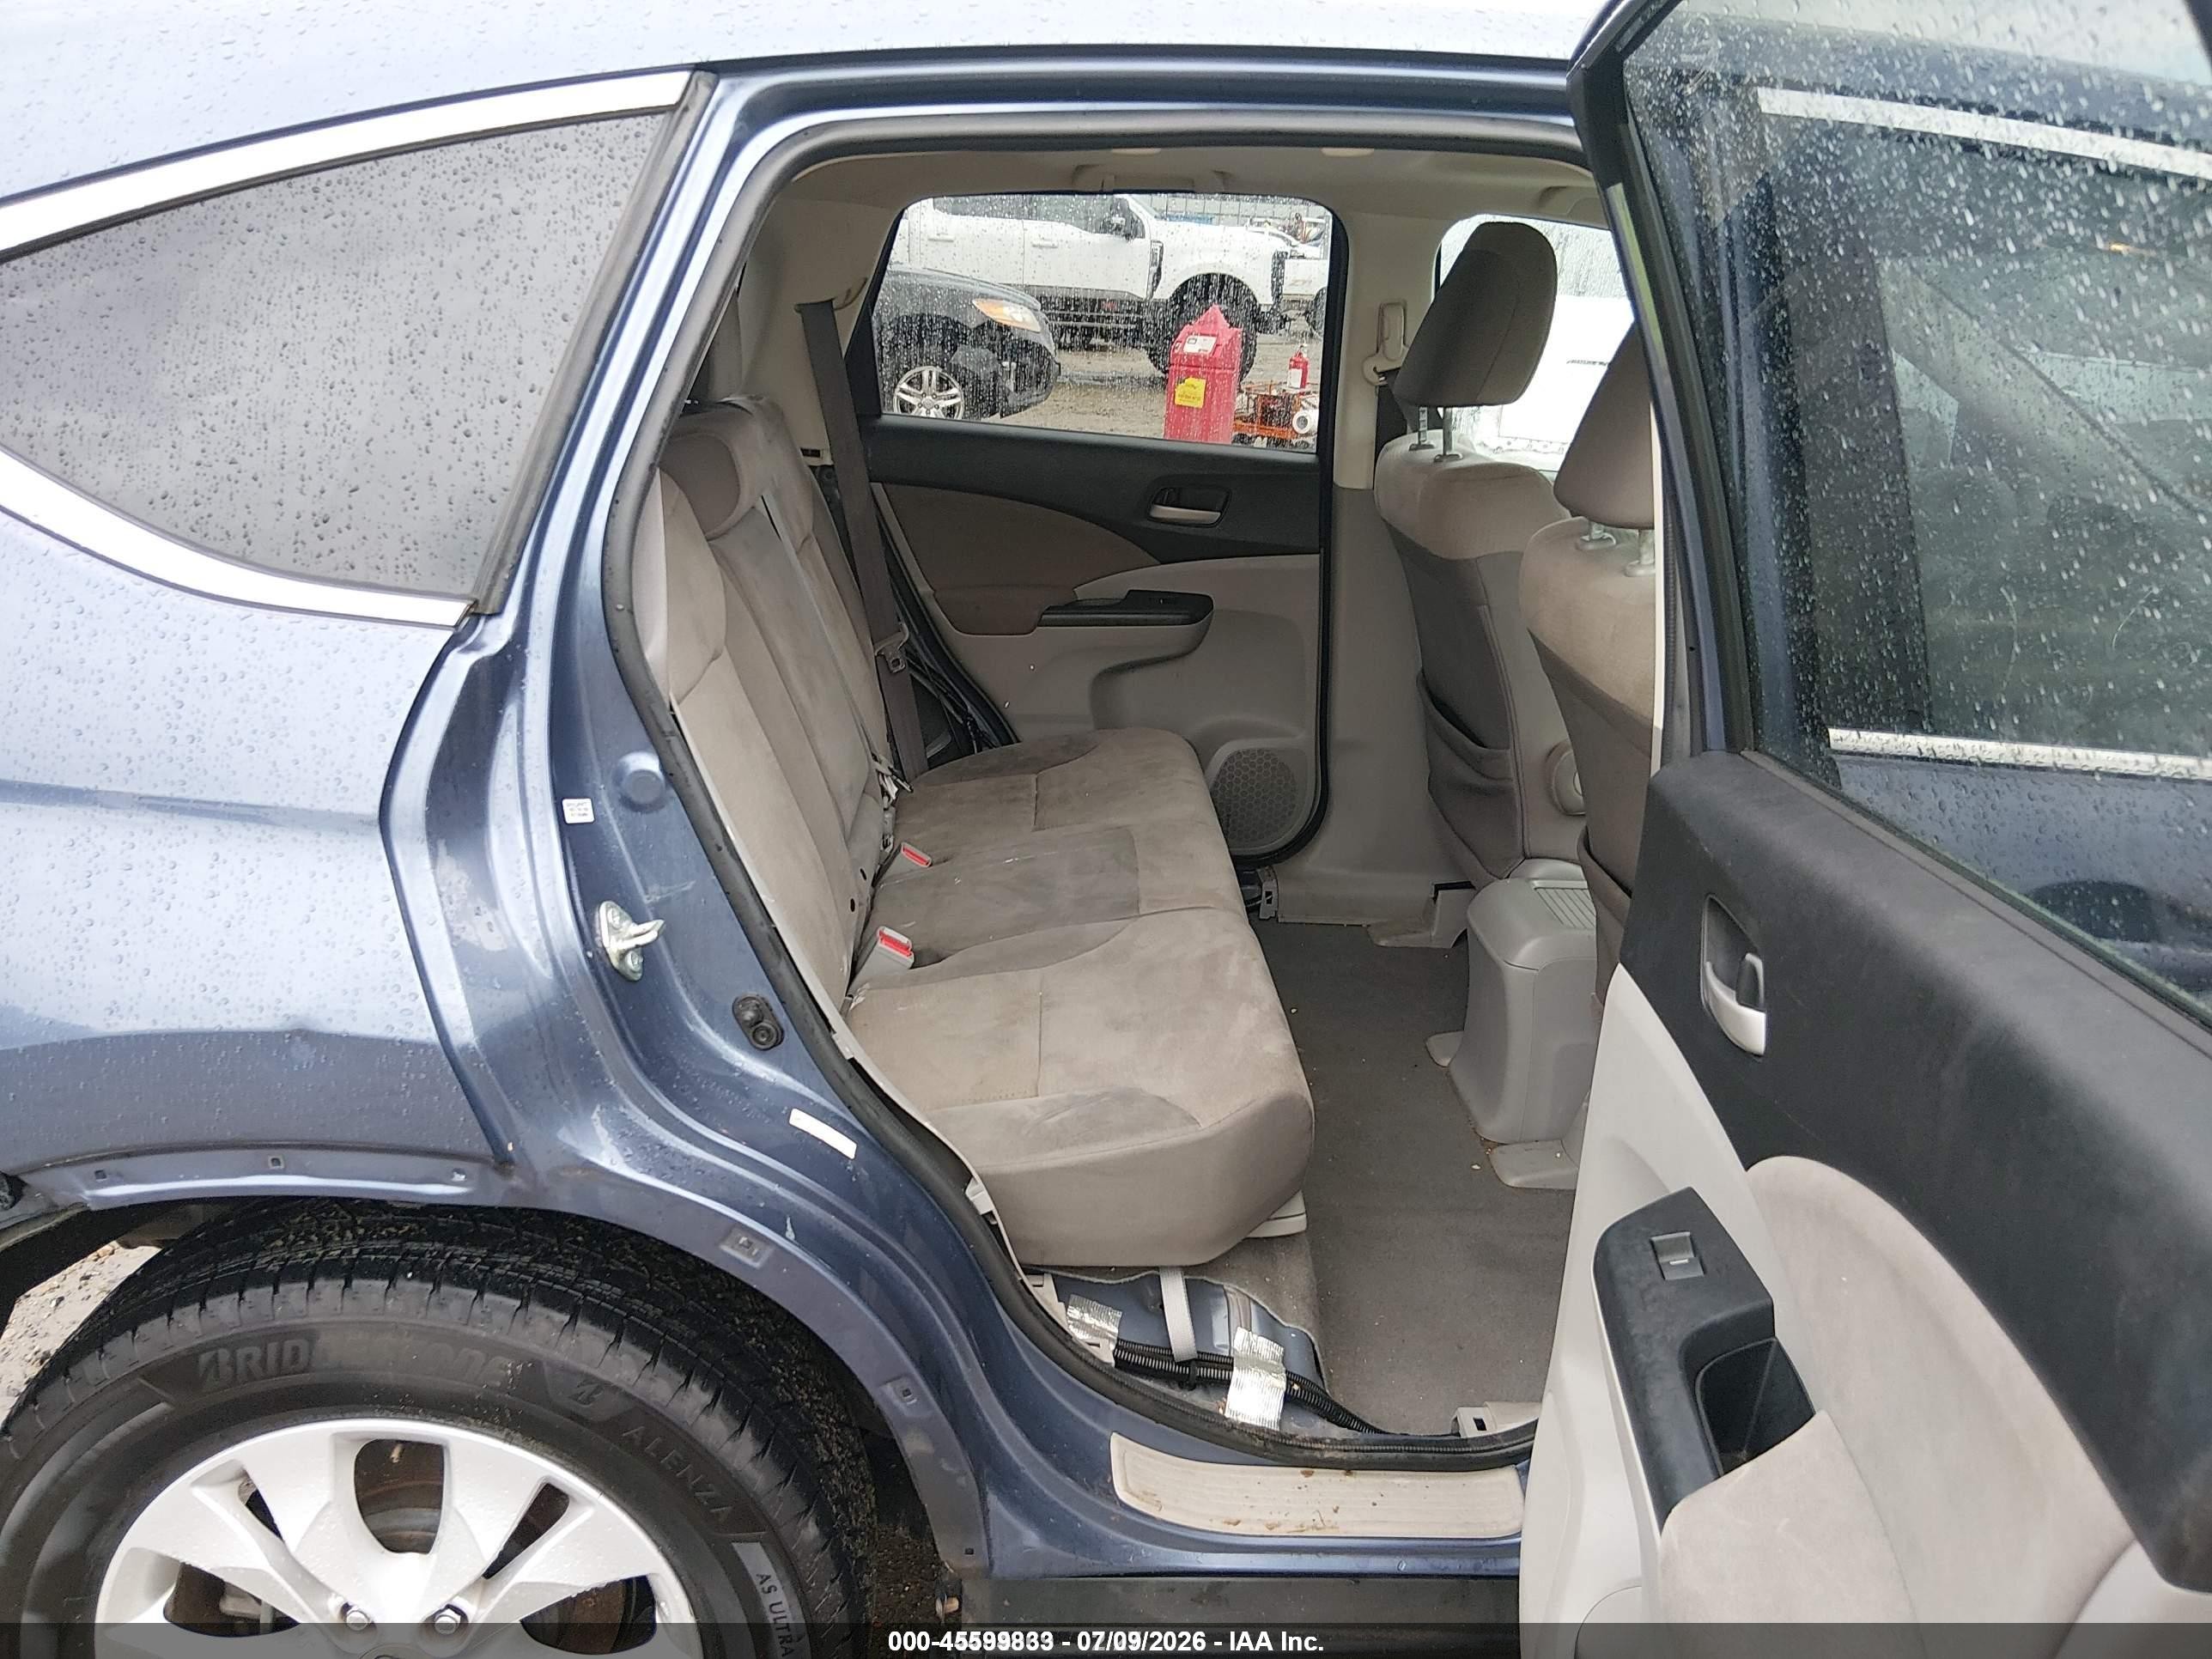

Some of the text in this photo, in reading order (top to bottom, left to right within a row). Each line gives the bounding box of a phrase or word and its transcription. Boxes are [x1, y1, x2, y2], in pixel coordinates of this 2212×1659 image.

[198, 1332, 514, 1393] BRIDONE
[621, 1425, 732, 1523] ALENZA
[756, 1572, 795, 1657] AS ULTRA
